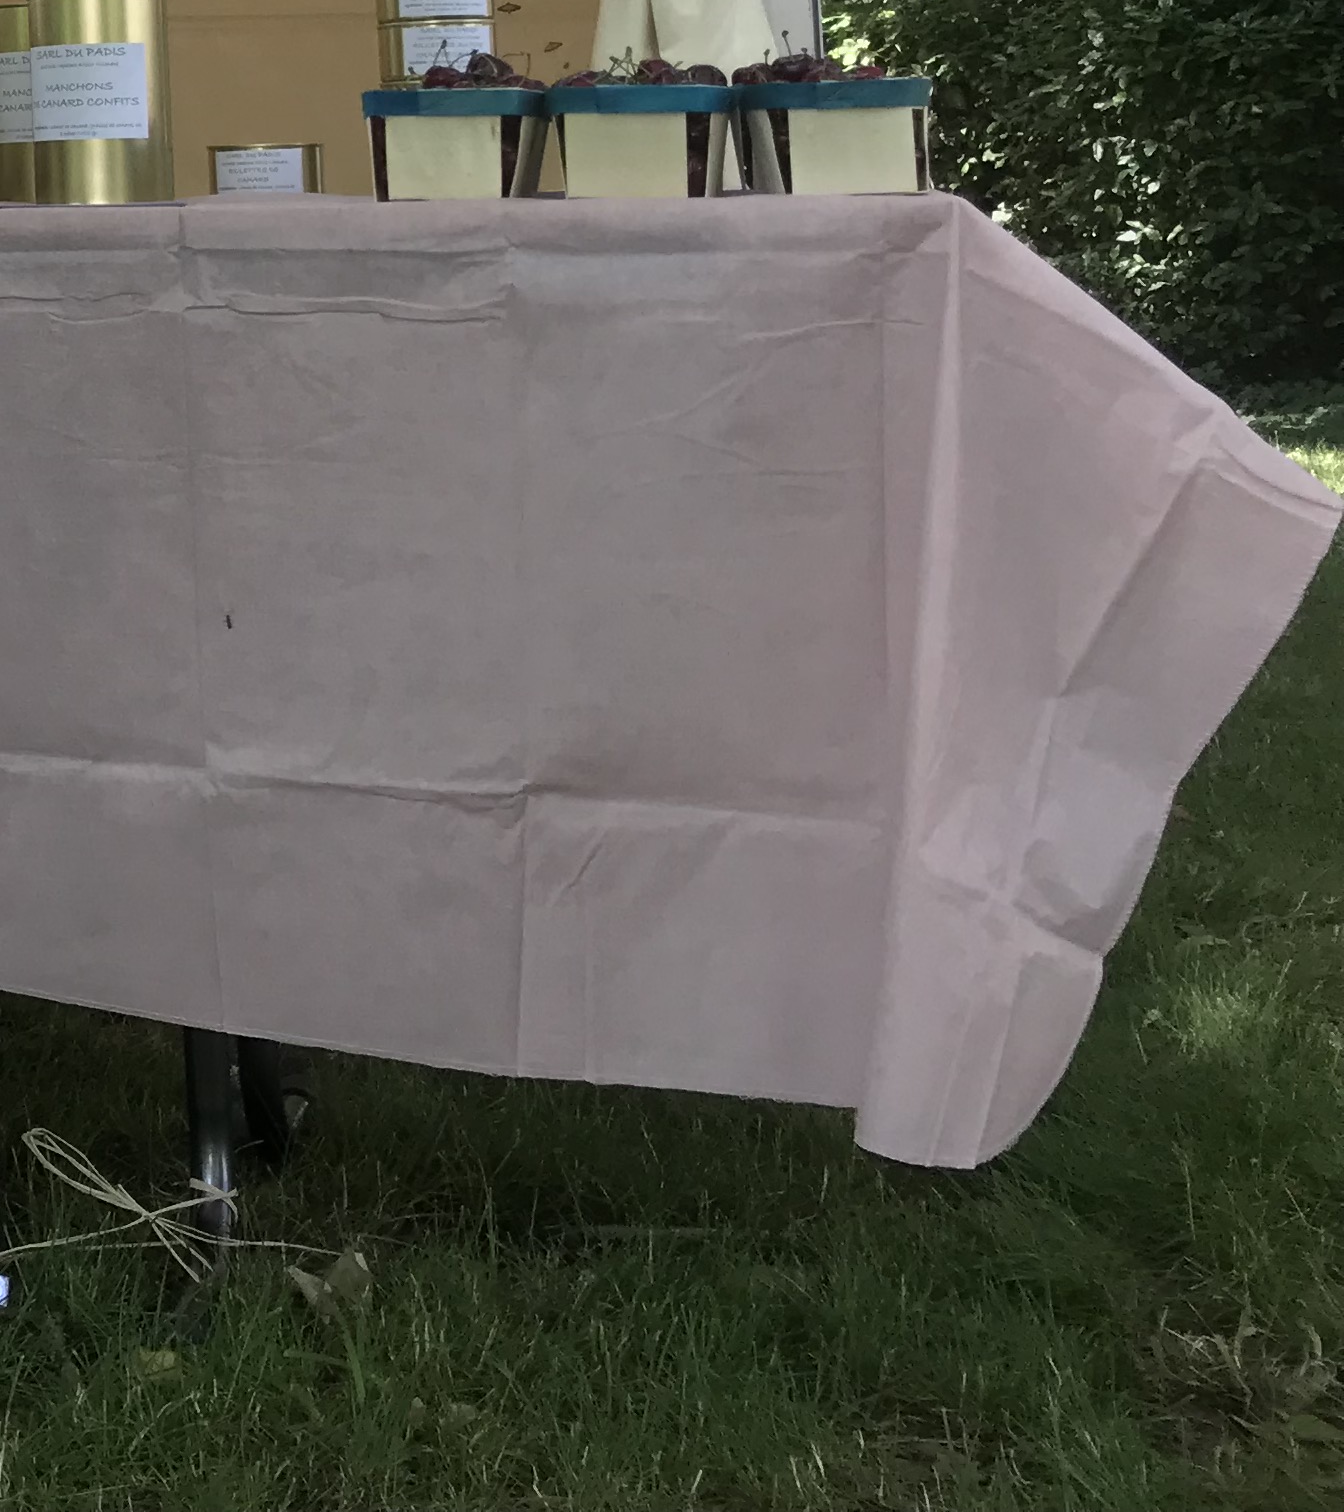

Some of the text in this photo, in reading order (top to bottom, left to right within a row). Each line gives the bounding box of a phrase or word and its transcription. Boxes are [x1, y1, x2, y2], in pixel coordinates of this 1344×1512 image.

[36, 46, 127, 60] SARL DU PADIS
[46, 81, 114, 92] MANCHONS
[41, 96, 141, 108] CANARD CONFITS
